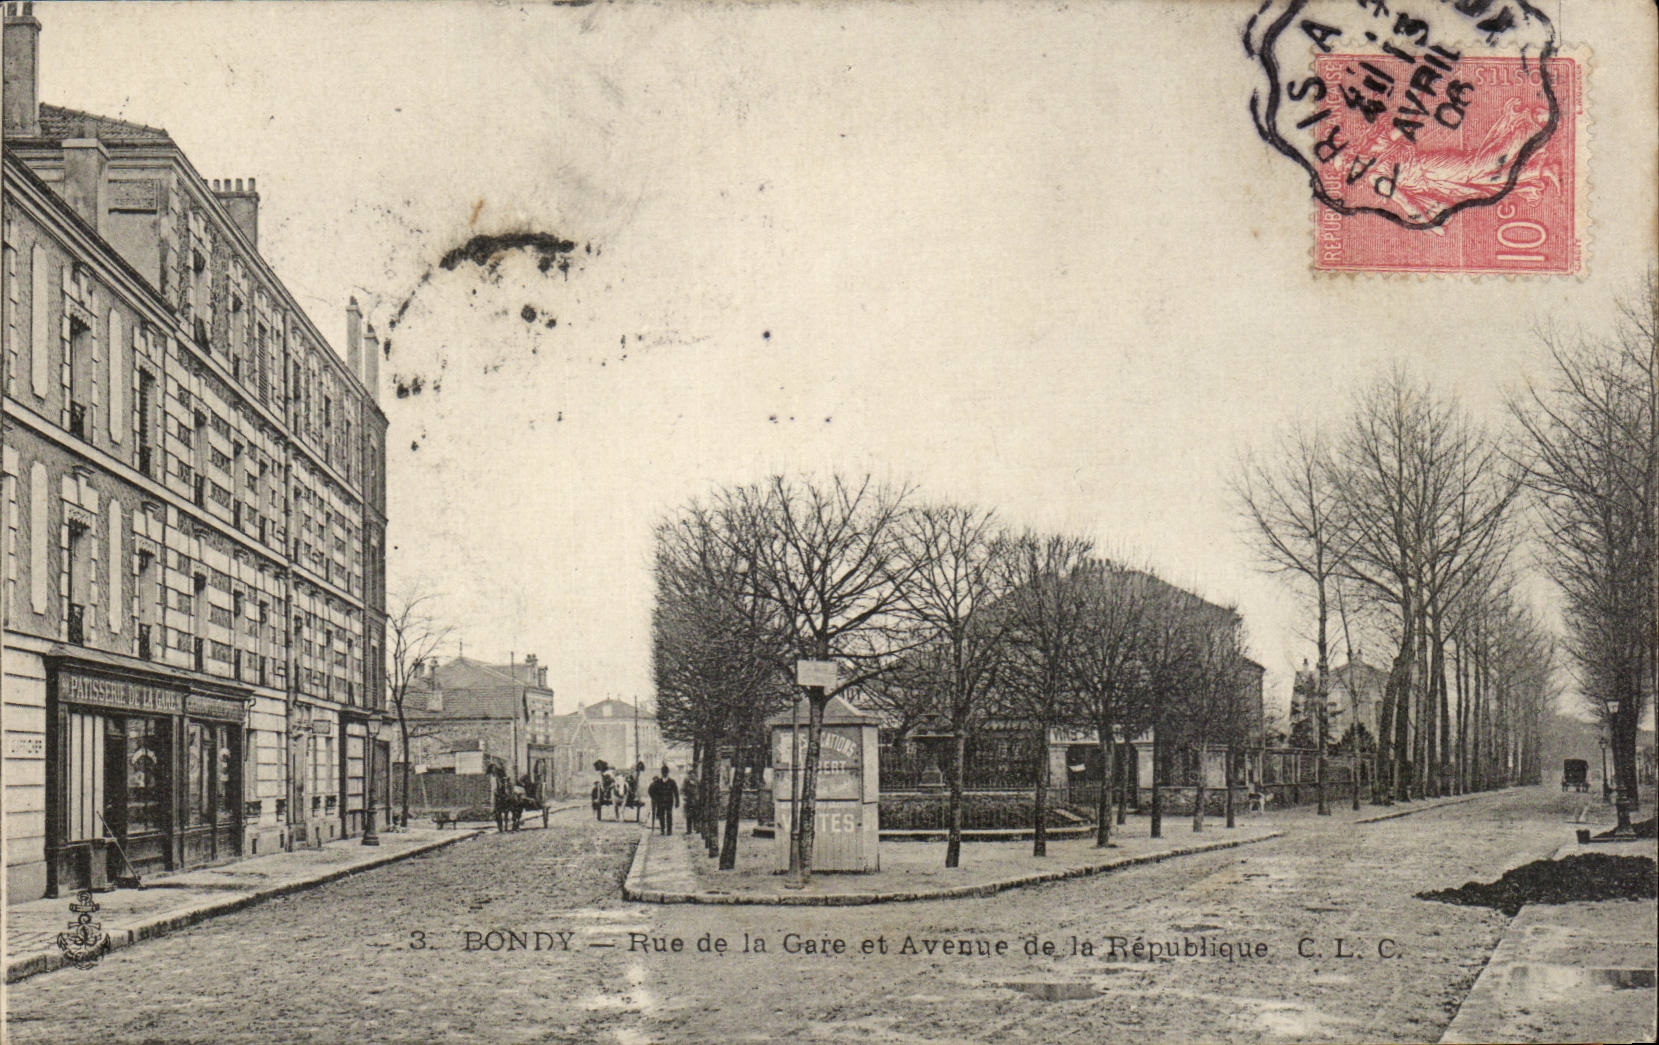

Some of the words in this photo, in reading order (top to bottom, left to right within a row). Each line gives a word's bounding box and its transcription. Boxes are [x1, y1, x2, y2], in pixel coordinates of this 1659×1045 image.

[1287, 75, 1400, 198] PARIS
[1393, 45, 1460, 143] AVRIL
[1323, 168, 1344, 262] REPUBQUE
[71, 676, 126, 704] PATISSERIE
[128, 685, 141, 706] DE
[143, 687, 154, 708] LA
[155, 687, 177, 710] GARE
[782, 813, 854, 833] VTES
